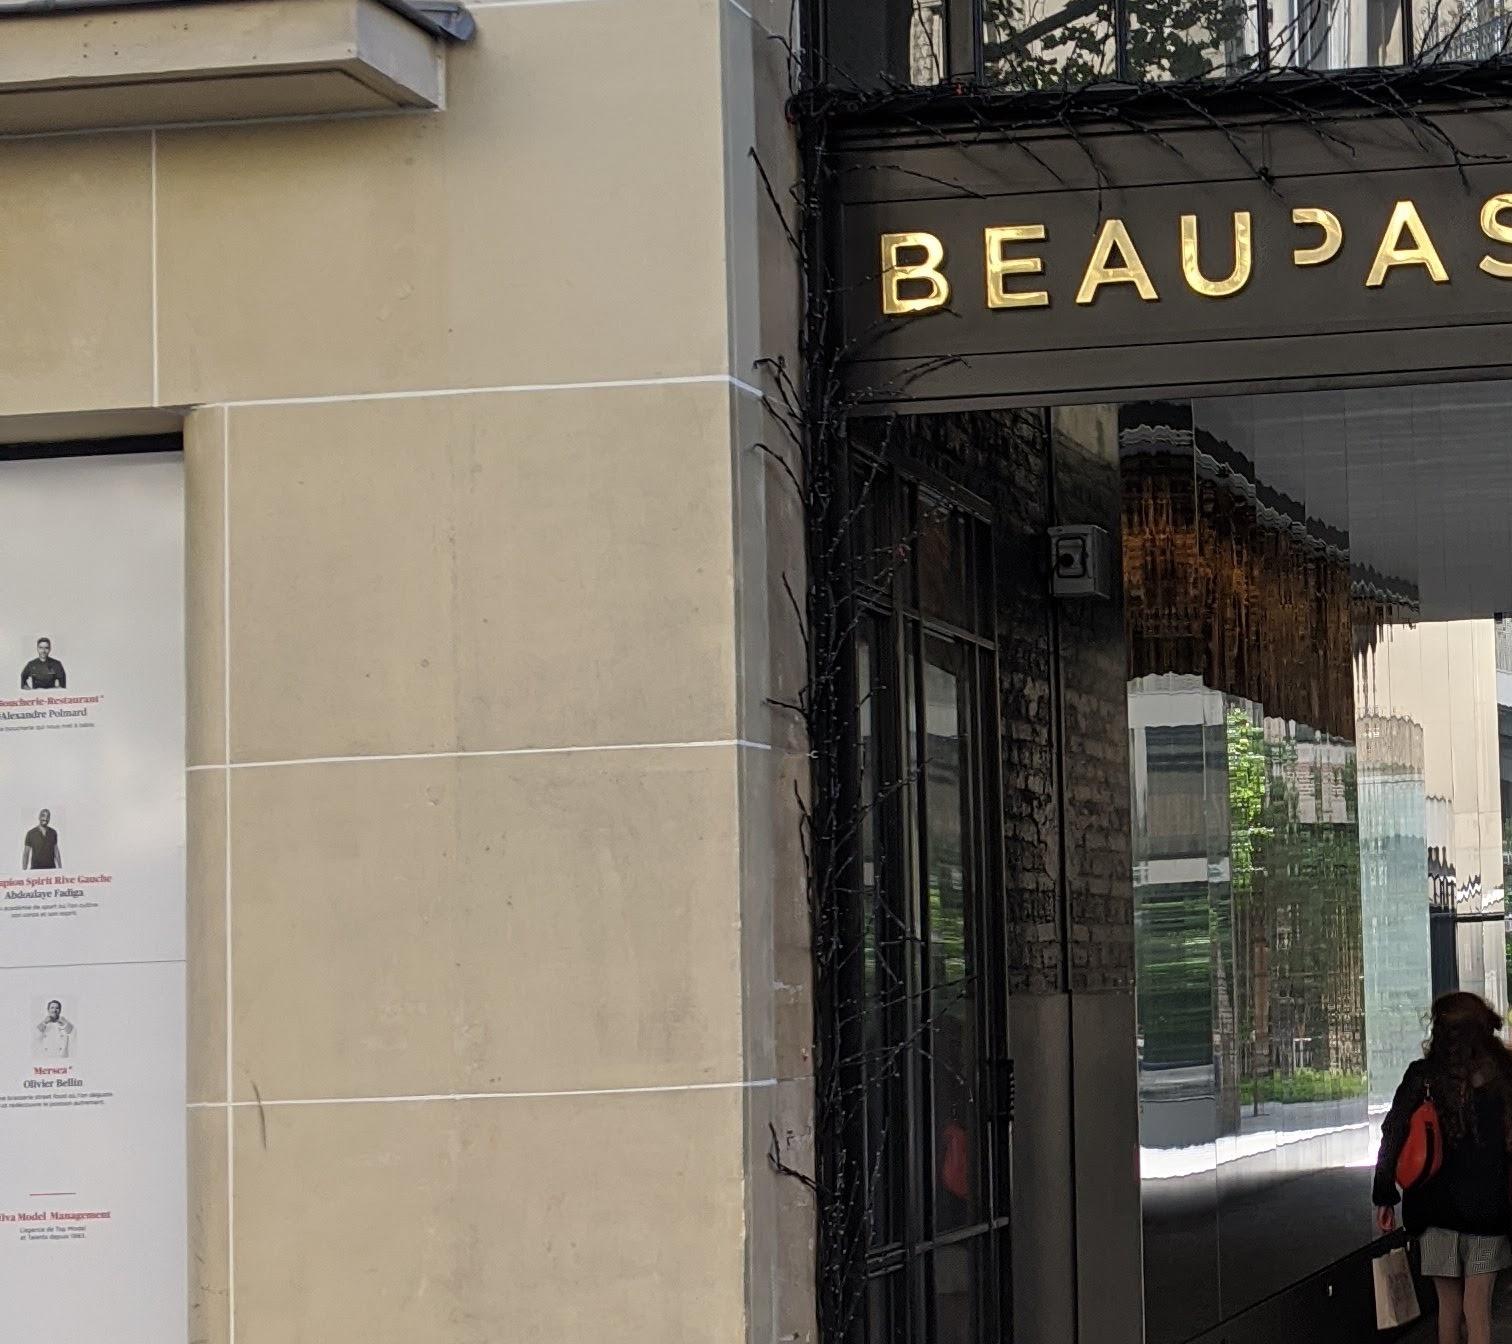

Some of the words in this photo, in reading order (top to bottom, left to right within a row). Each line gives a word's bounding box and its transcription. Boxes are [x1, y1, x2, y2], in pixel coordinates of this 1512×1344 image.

[26, 876, 53, 887] Spirit
[54, 875, 75, 885] Rive
[77, 874, 112, 884] Gauche
[23, 1079, 54, 1088] Olivier
[56, 1078, 83, 1087] Bellin
[18, 1211, 46, 1221] Model
[50, 1211, 110, 1222] Management
